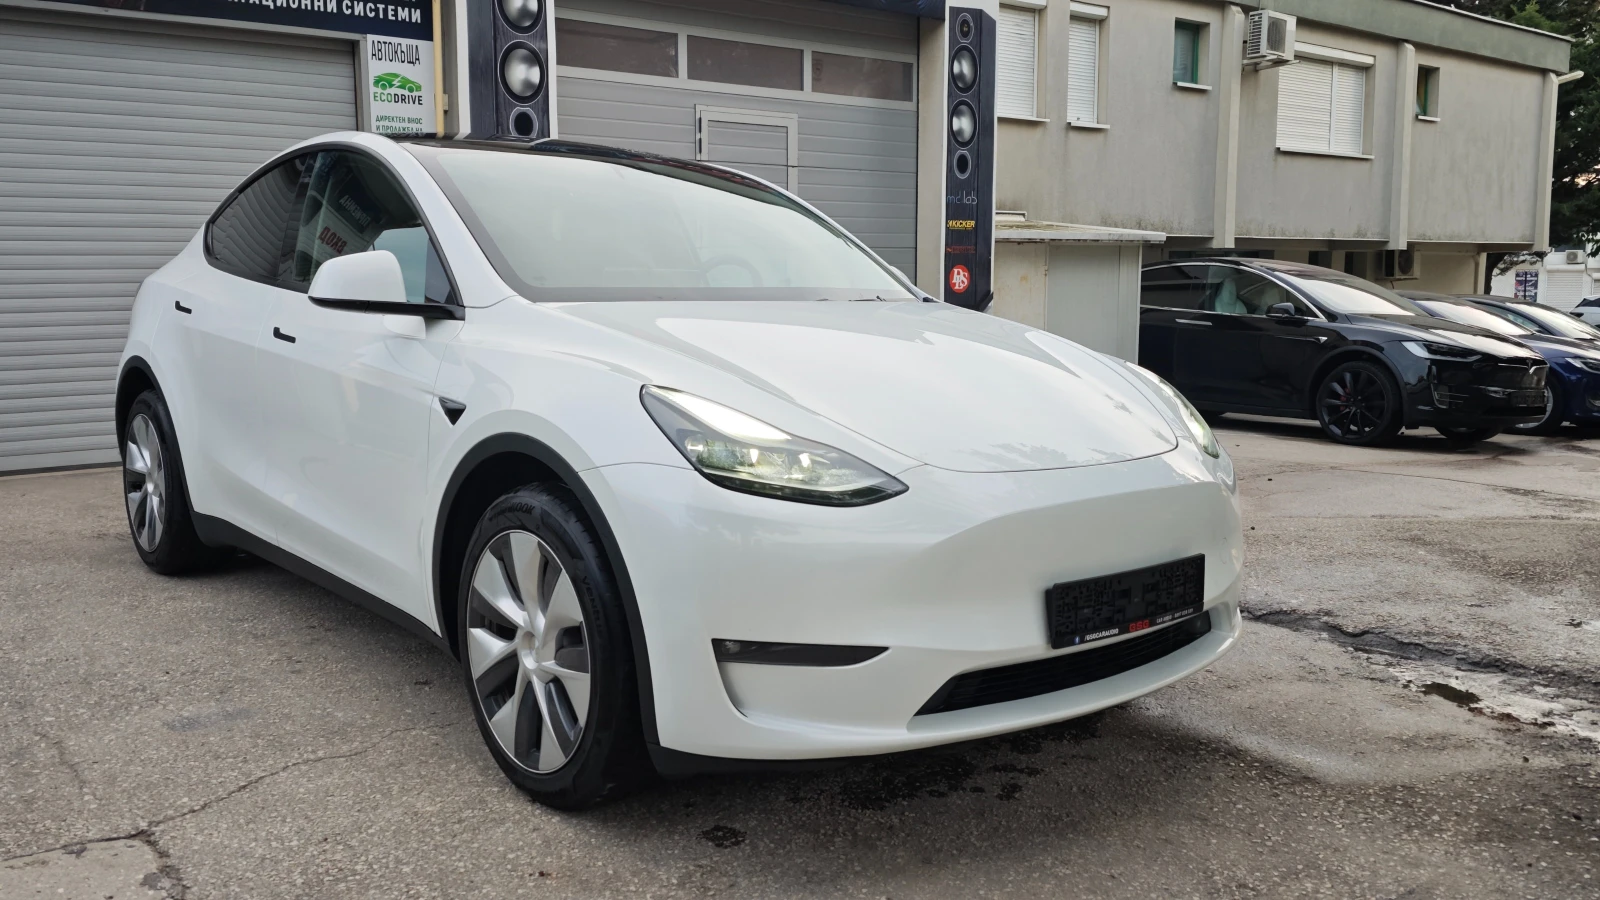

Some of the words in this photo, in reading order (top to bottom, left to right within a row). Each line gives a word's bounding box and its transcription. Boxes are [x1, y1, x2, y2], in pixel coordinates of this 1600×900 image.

[342, 0, 421, 24] СИСТЕМИ
[371, 39, 421, 66] АВТОКЪЩА
[373, 91, 423, 106] ECODRIVE
[375, 114, 406, 124] ДИРЕКТЕН
[407, 117, 423, 125] ВНОС
[375, 124, 381, 132] И
[1129, 620, 1149, 632] GSG
